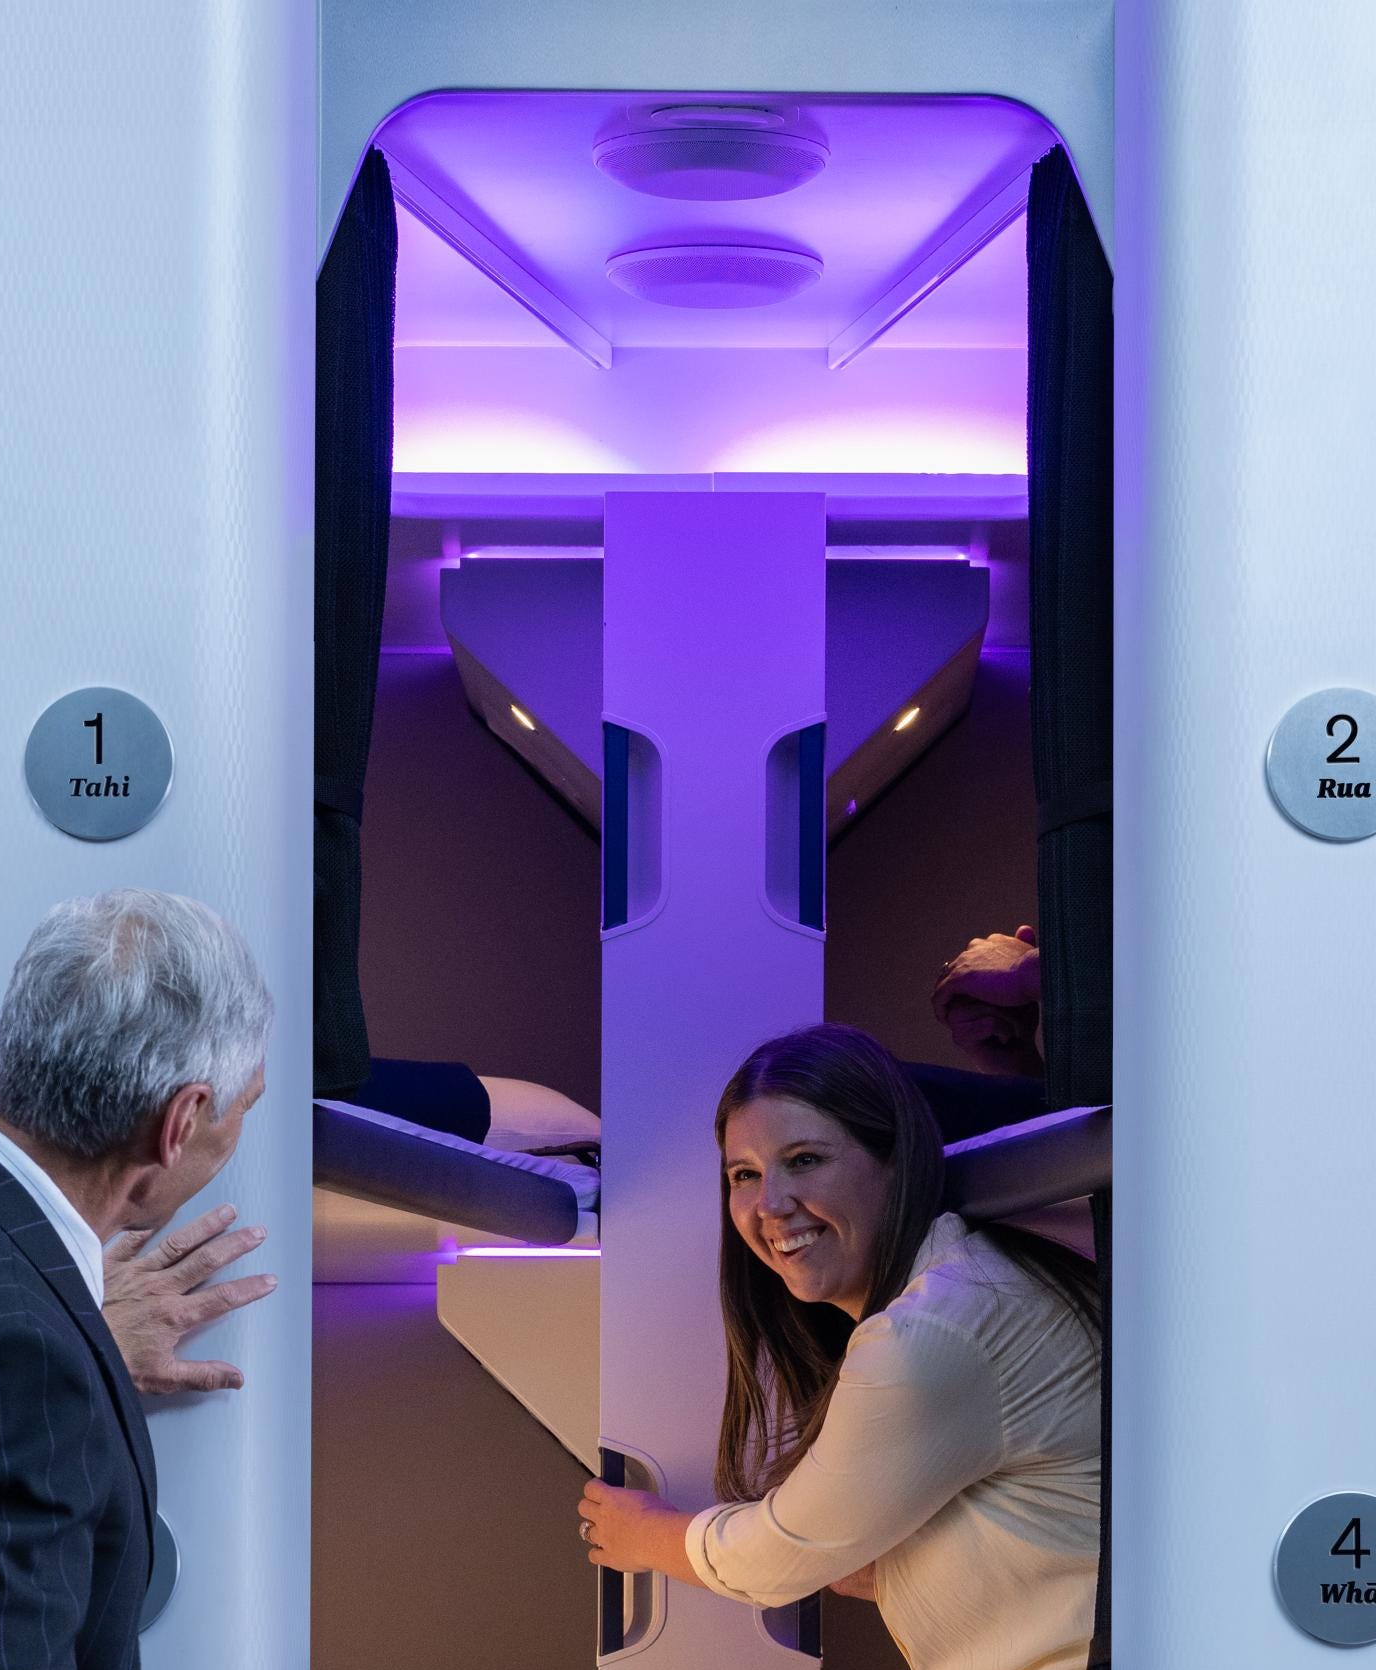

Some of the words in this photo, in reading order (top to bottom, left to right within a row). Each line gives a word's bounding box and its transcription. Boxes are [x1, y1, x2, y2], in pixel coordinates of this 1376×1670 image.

[83, 712, 103, 765] 1
[1326, 714, 1360, 764] 2
[69, 775, 131, 797] Tahi
[1316, 778, 1372, 799] Rua
[1330, 1517, 1371, 1569] 4
